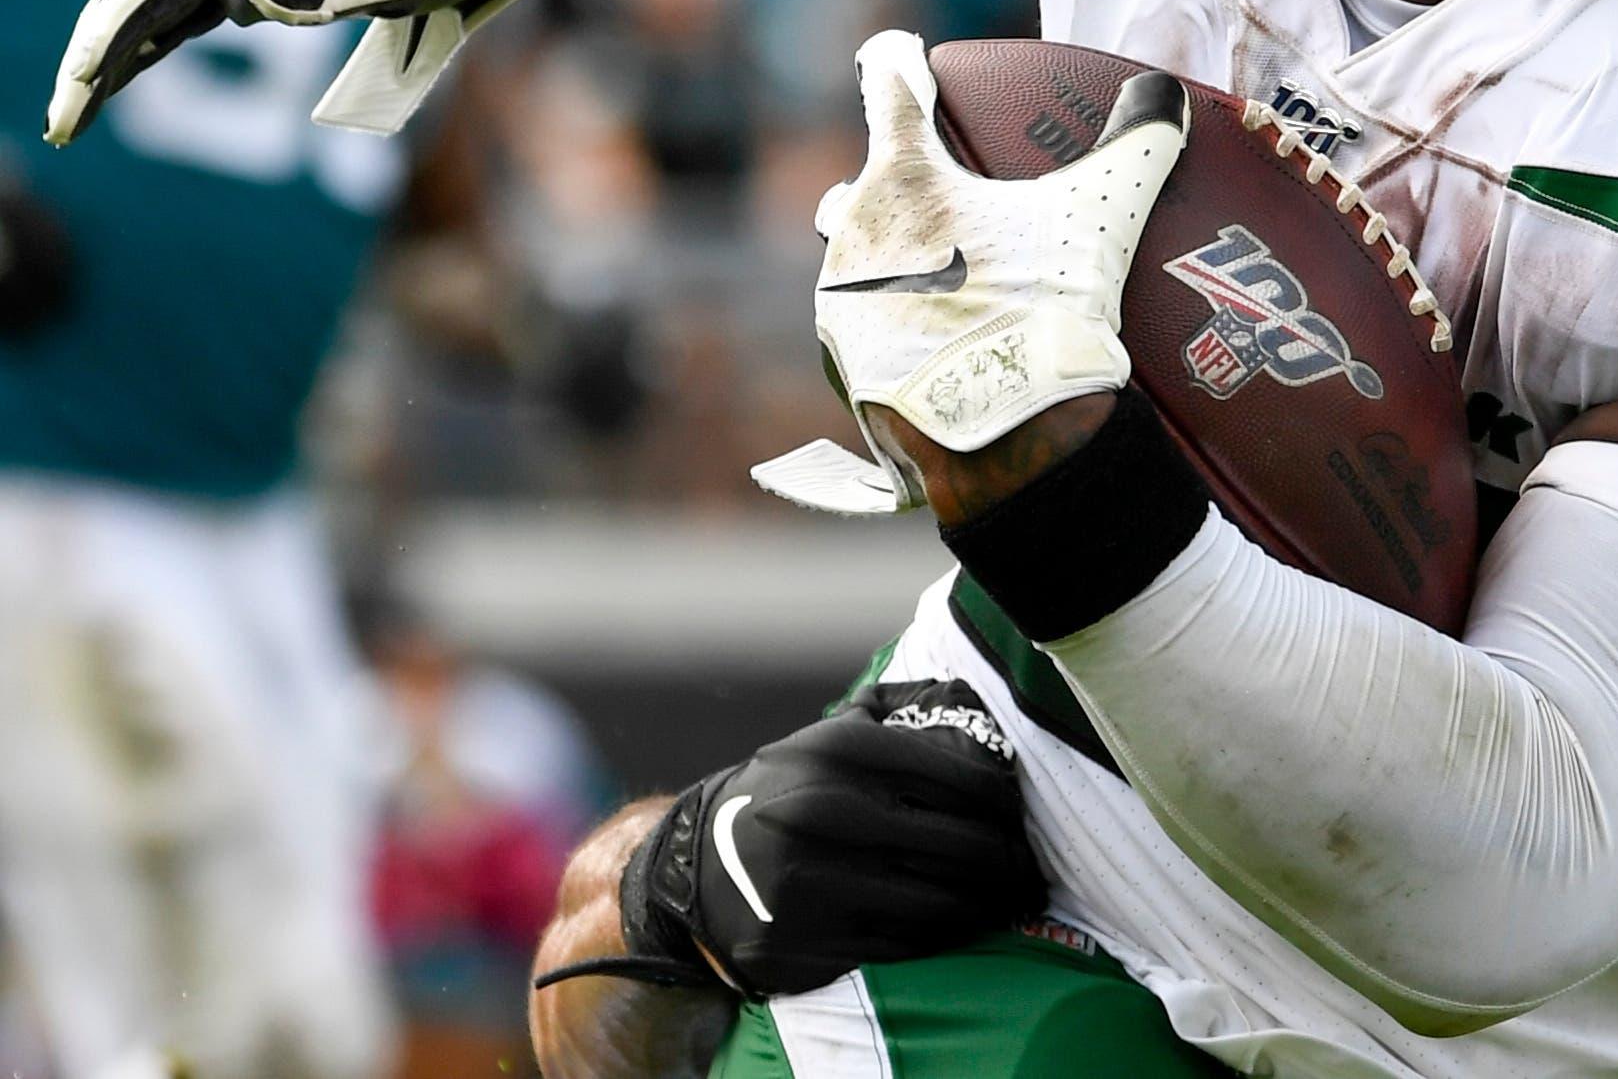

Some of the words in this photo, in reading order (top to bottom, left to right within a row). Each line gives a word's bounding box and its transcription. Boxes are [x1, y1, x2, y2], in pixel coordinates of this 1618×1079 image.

[1269, 77, 1343, 158] 100
[1165, 224, 1354, 387] 100
[1188, 331, 1243, 389] NFL
